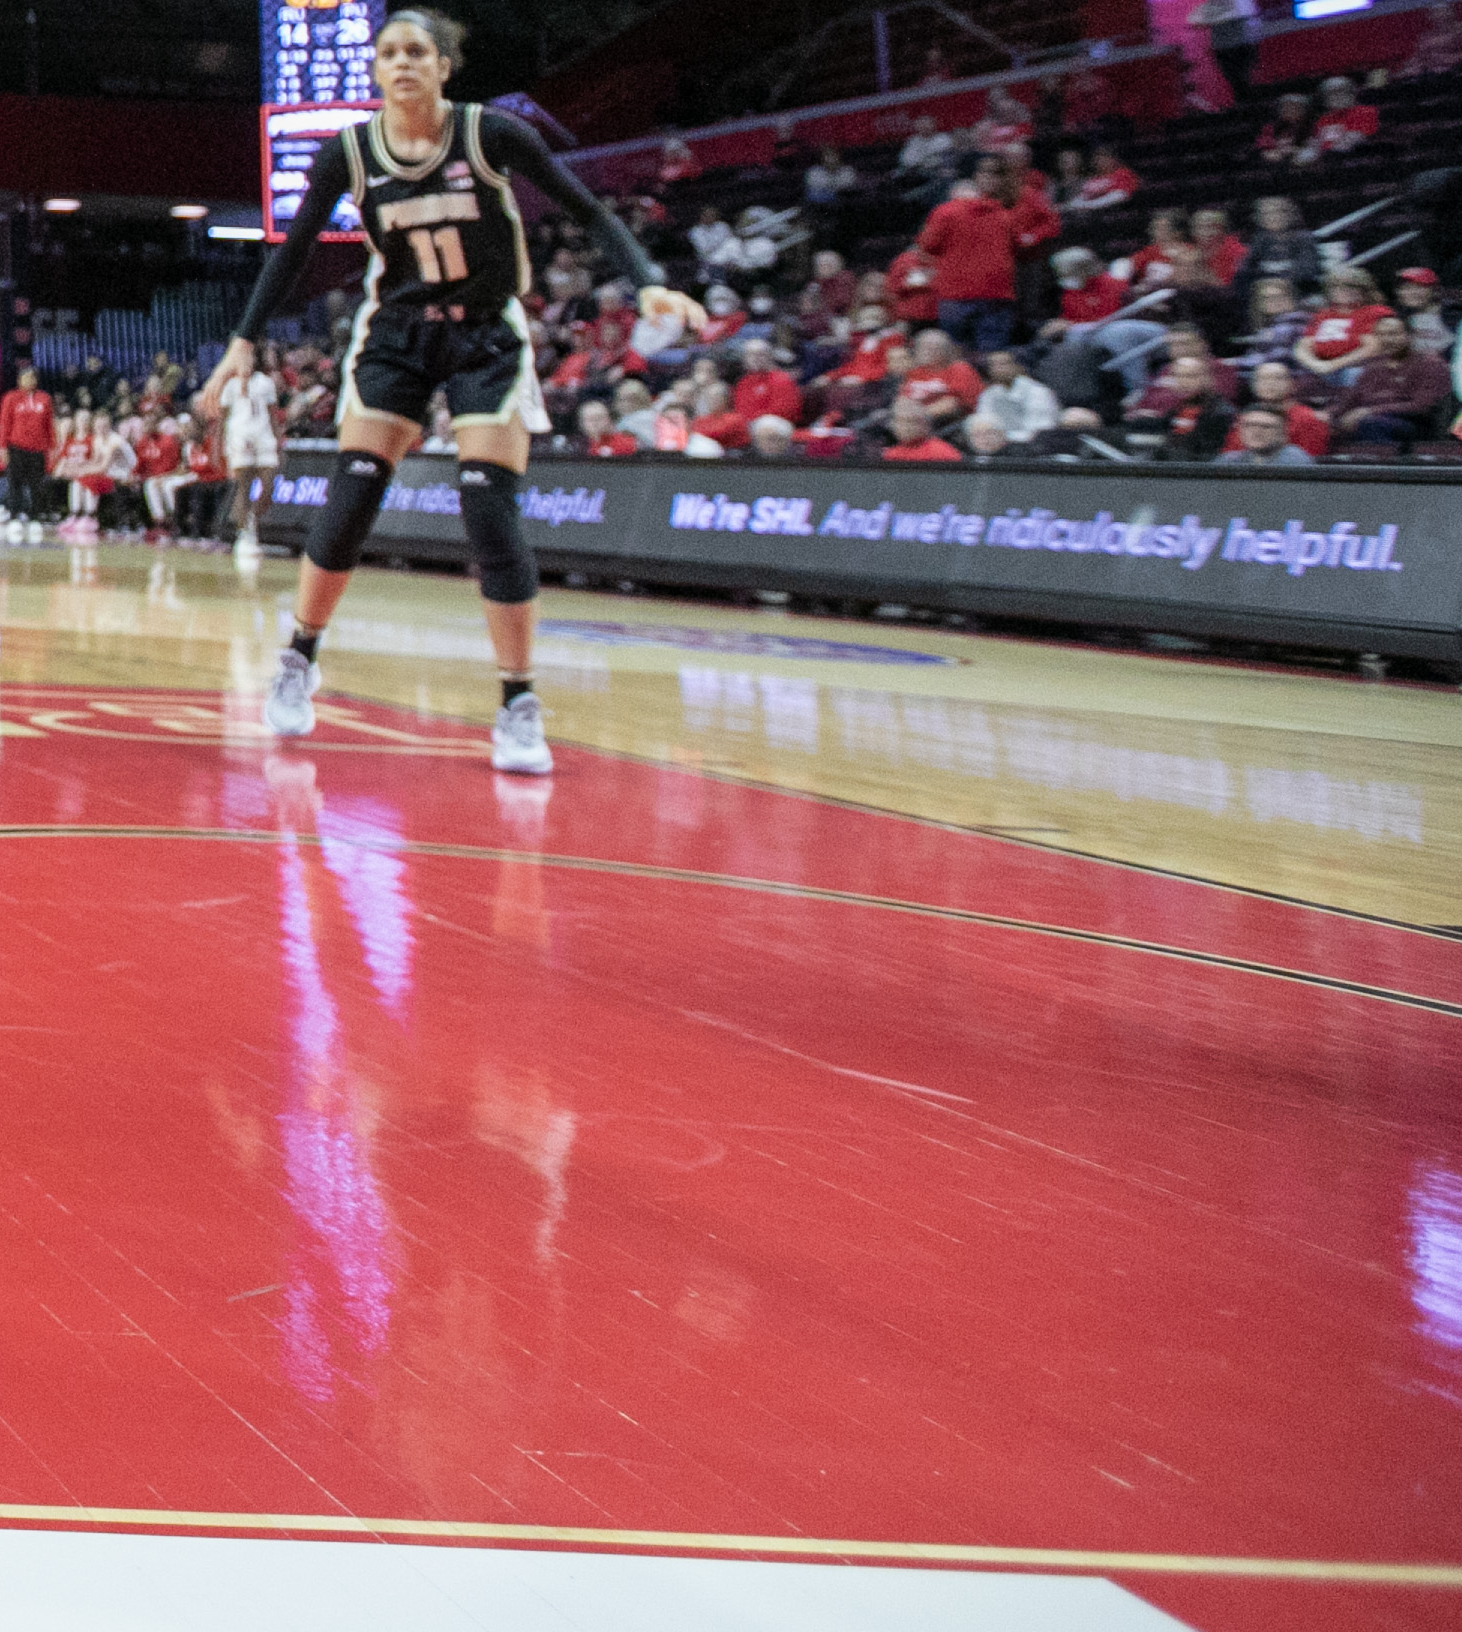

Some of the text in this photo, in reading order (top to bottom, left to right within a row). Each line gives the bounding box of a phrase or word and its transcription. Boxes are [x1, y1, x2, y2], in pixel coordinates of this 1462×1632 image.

[407, 225, 469, 283] 11
[671, 492, 747, 533] We're
[818, 500, 889, 541] And
[891, 506, 979, 547] we're
[984, 508, 1222, 570] ridiculously
[1221, 518, 1404, 576] helpful.
